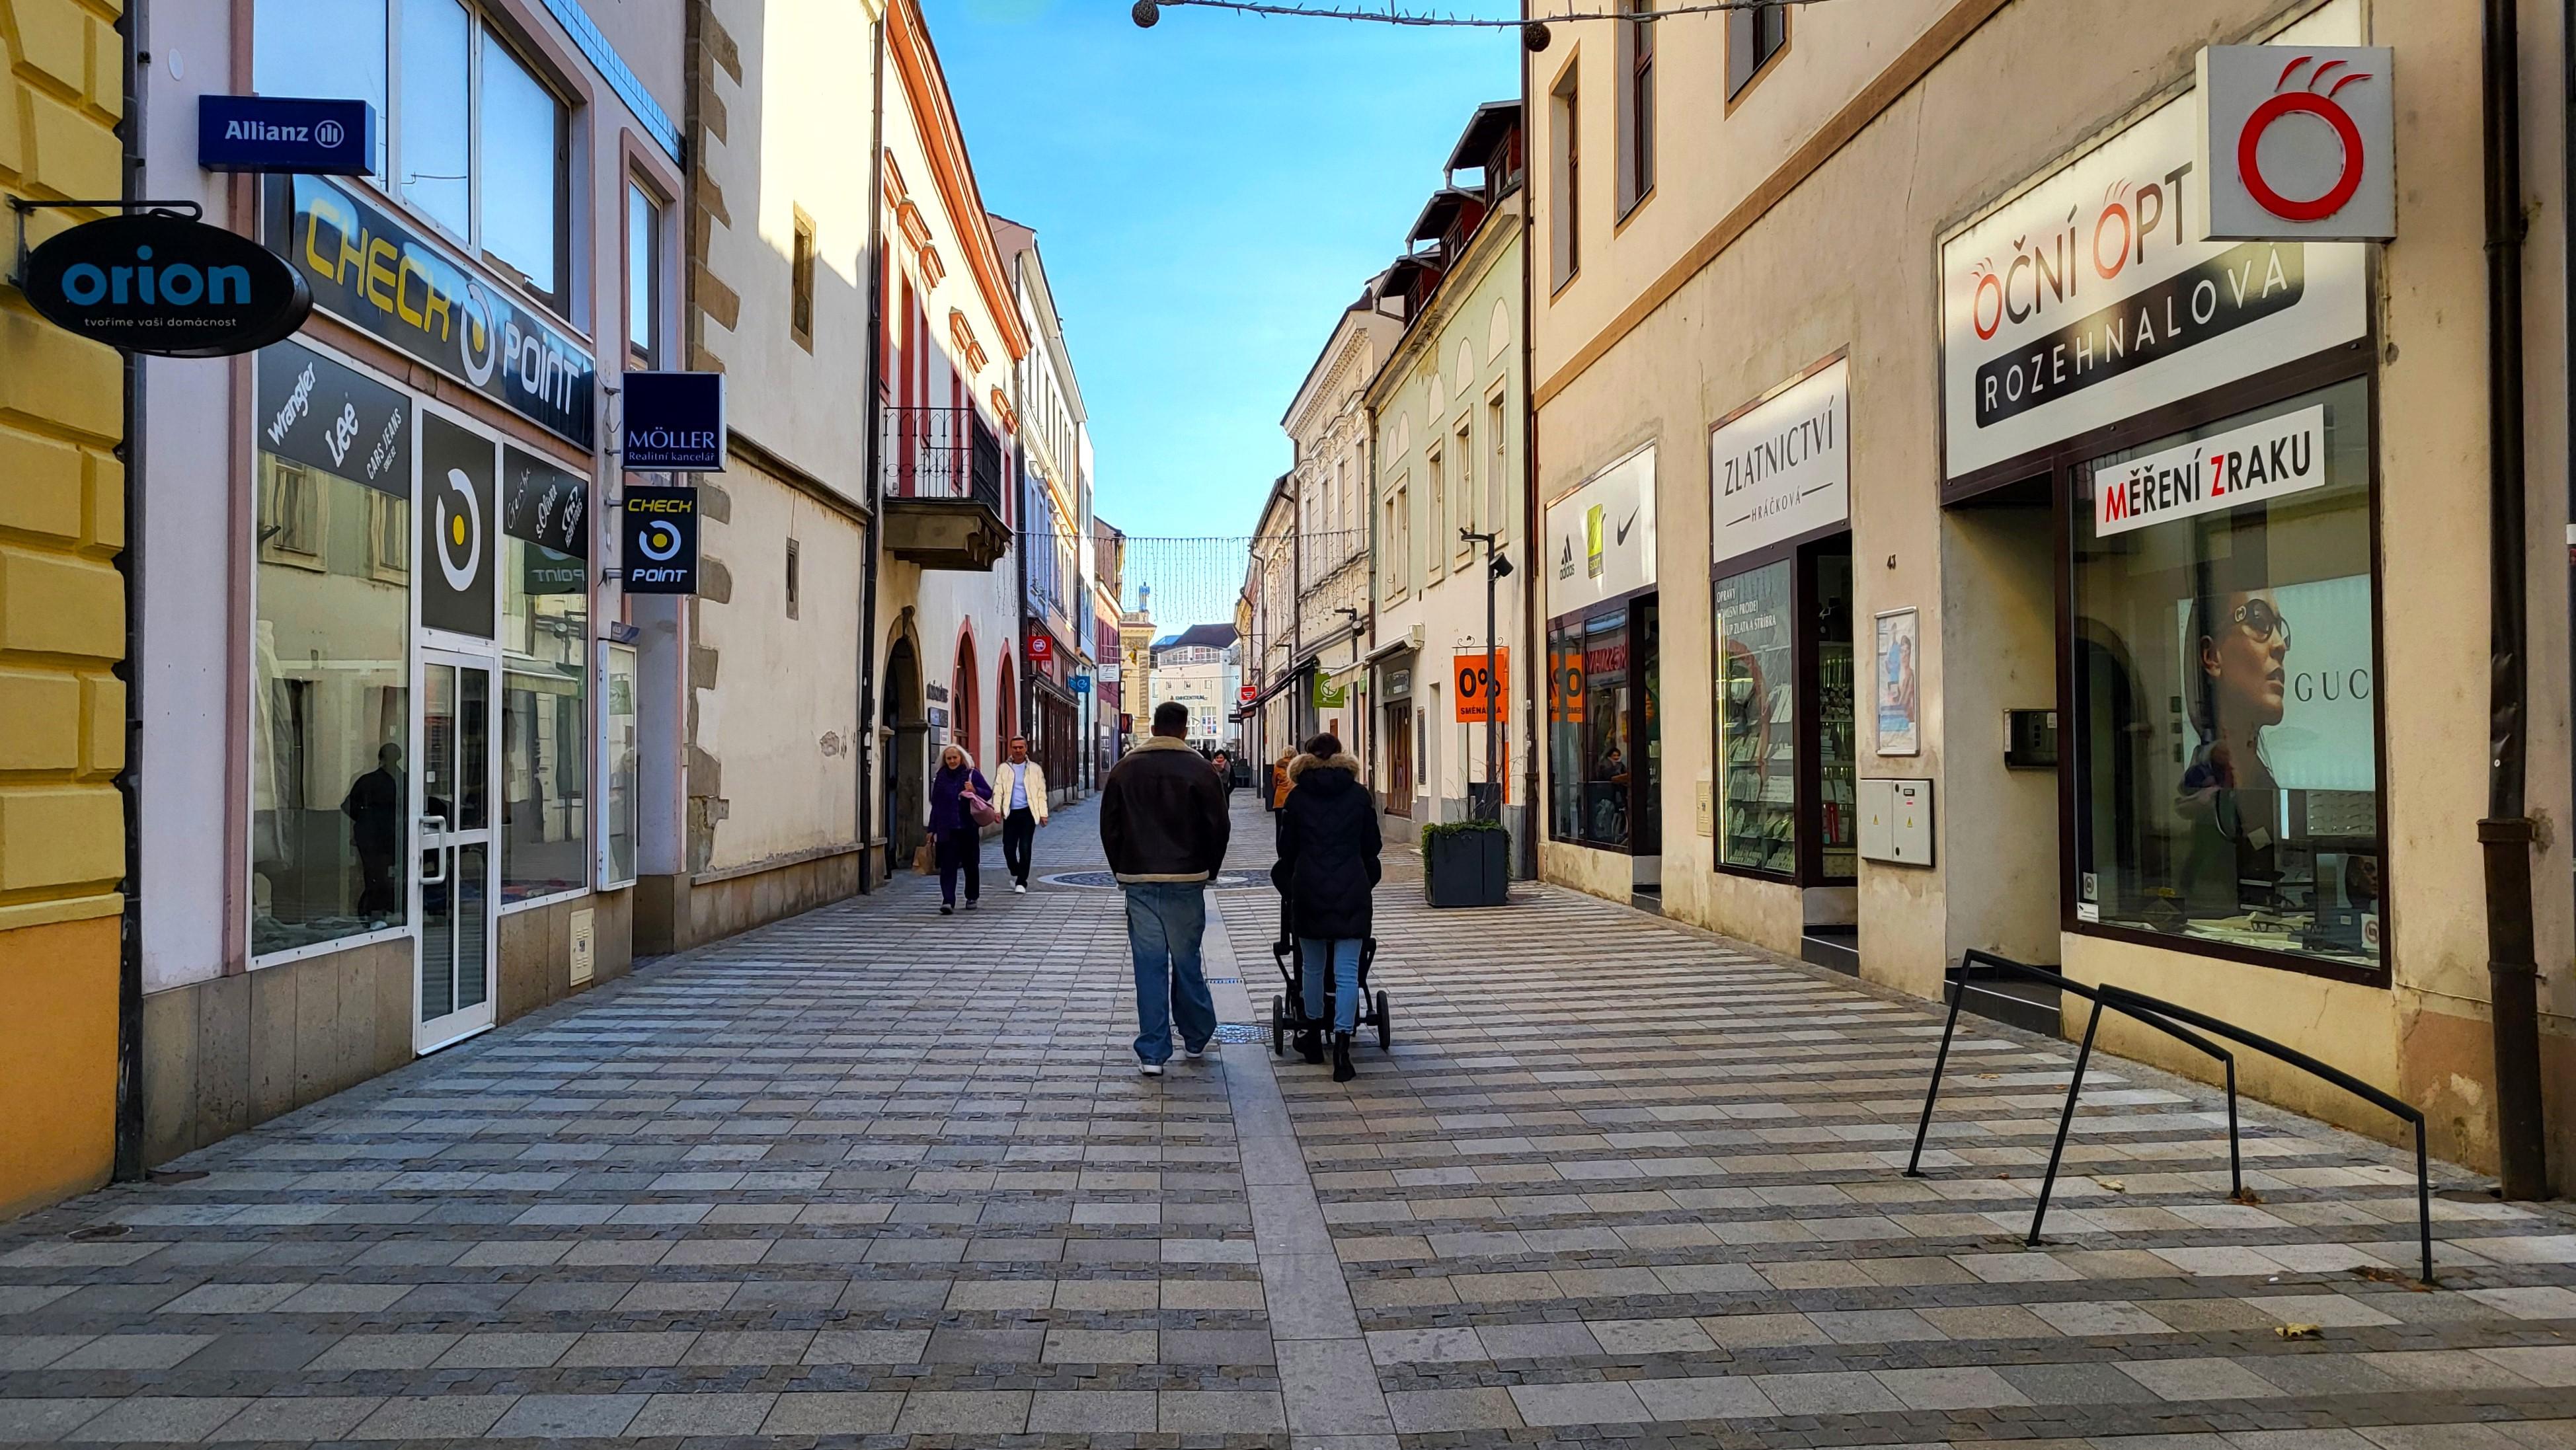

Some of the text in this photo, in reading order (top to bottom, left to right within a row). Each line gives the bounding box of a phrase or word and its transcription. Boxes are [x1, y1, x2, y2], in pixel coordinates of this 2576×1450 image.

[225, 120, 309, 142] Allianz
[1971, 161, 2193, 340] OČNÍ OPT
[61, 245, 251, 306] orion
[305, 198, 452, 342] CHECK
[85, 317, 134, 327] tvoříme
[167, 316, 237, 327] domácnost
[267, 362, 316, 446] Wrangler
[325, 402, 359, 468] Lee
[367, 408, 402, 480] CARS JEANS
[629, 427, 715, 448] MÖLLER
[1725, 395, 1834, 496] ZLATNICTVÍ
[629, 451, 715, 461] Realitní kancelář
[2105, 430, 2312, 523] MĚŘENÍ ZRAKU
[628, 499, 693, 513] CHECK
[1752, 485, 1801, 523] HRÁČKOVÁ
[1559, 561, 1575, 580] adidas
[1717, 588, 1736, 603] OPRAVY
[1739, 599, 1758, 615] PRODEJ
[1734, 621, 1749, 634] ZLATA
[1750, 619, 1754, 630] A
[1754, 613, 1777, 630] STŘÍBRA
[1459, 668, 1501, 698] 0%
[2294, 668, 2369, 702] GUC
[1460, 705, 1502, 715] SMĚNÁA
